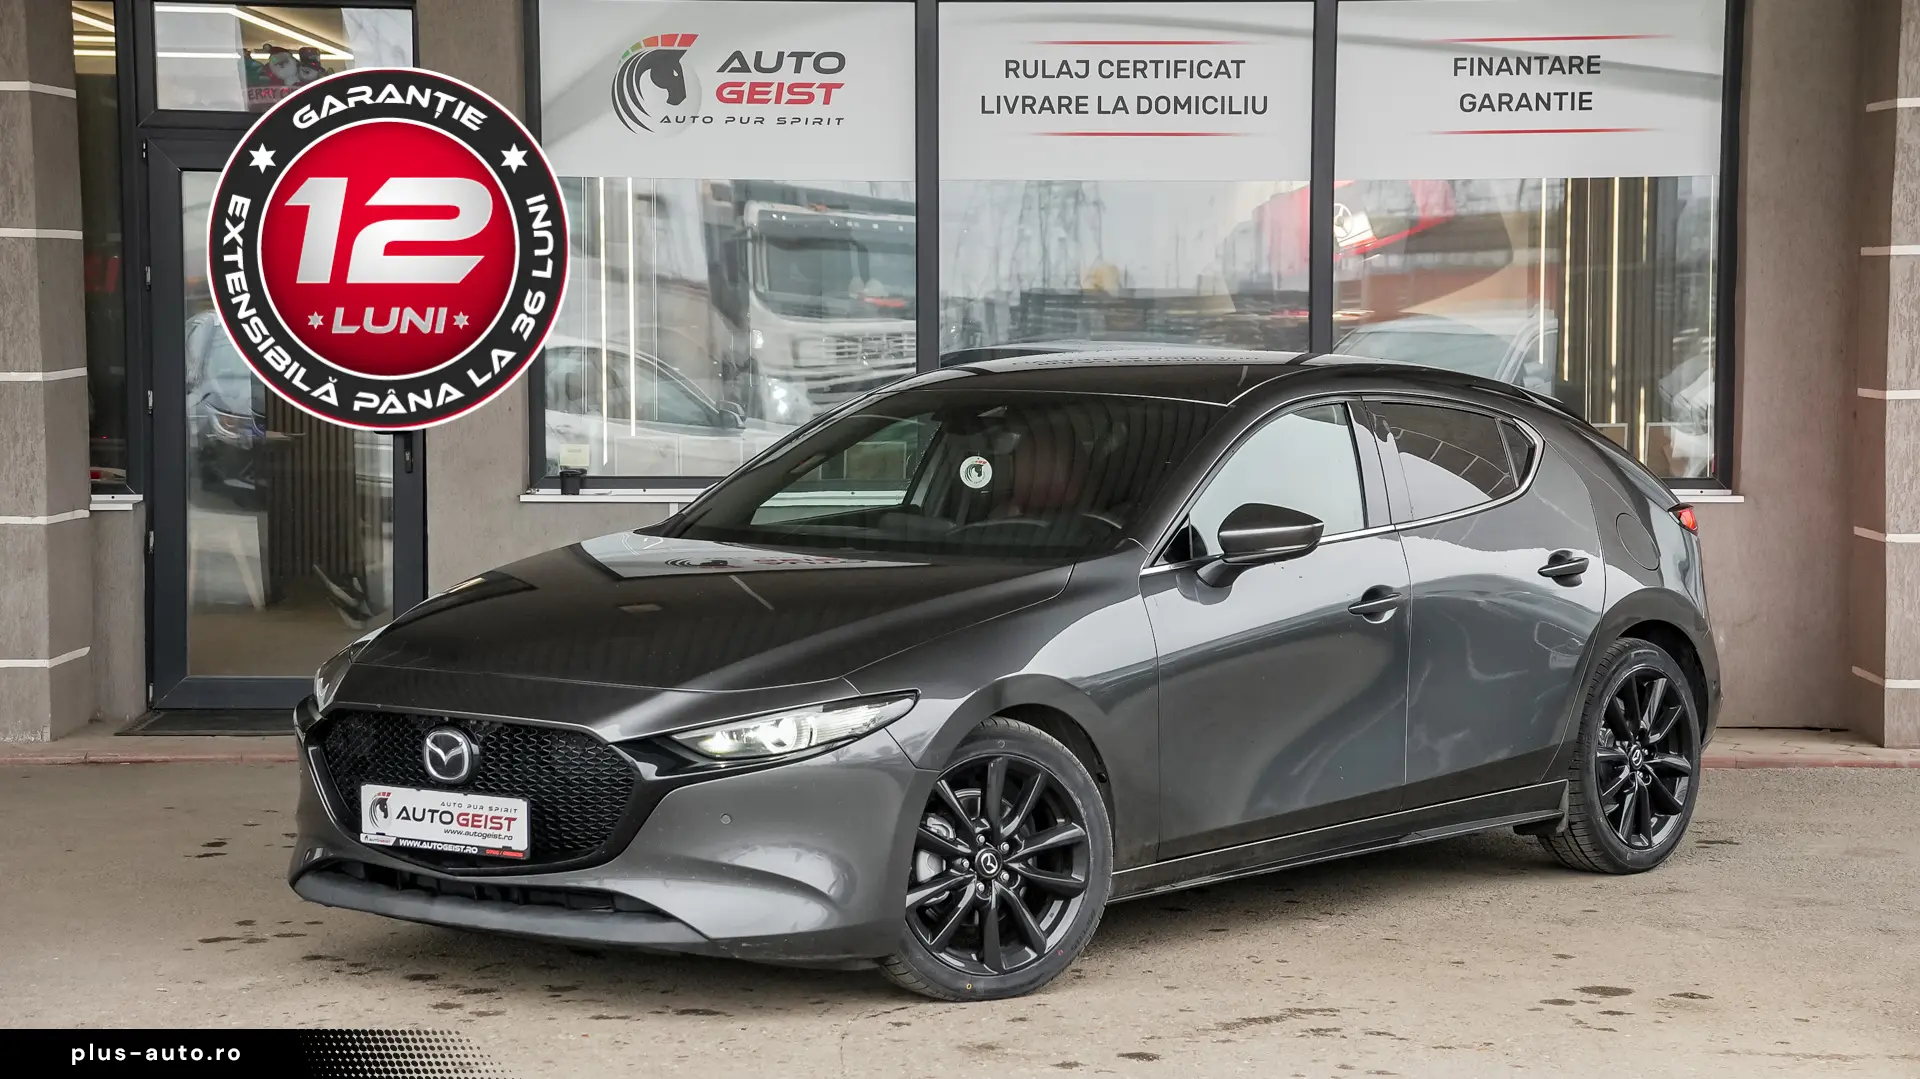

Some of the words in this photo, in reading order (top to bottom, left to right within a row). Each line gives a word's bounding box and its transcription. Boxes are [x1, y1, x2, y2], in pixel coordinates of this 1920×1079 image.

[716, 50, 846, 74] AUTO
[1005, 59, 1090, 79] RULAJ
[1098, 59, 1246, 79] CERTIFICAT
[1453, 55, 1601, 77] FINANTARE
[715, 82, 845, 105] GEIST
[1459, 91, 1593, 112] GARANTIE
[981, 95, 1089, 115] LIVRARE
[1097, 95, 1129, 115] LA
[1136, 95, 1268, 115] DOMICILIU
[660, 115, 714, 124] AUTO
[725, 116, 764, 125] PUR
[776, 117, 844, 126] SPIRIT
[440, 801, 463, 809] AUTO
[466, 803, 484, 811] PUR
[488, 806, 518, 814] SPIRIT
[443, 828, 513, 841] www.autogeist.ro
[399, 838, 478, 854] WWW.AUTOGEIST.RO
